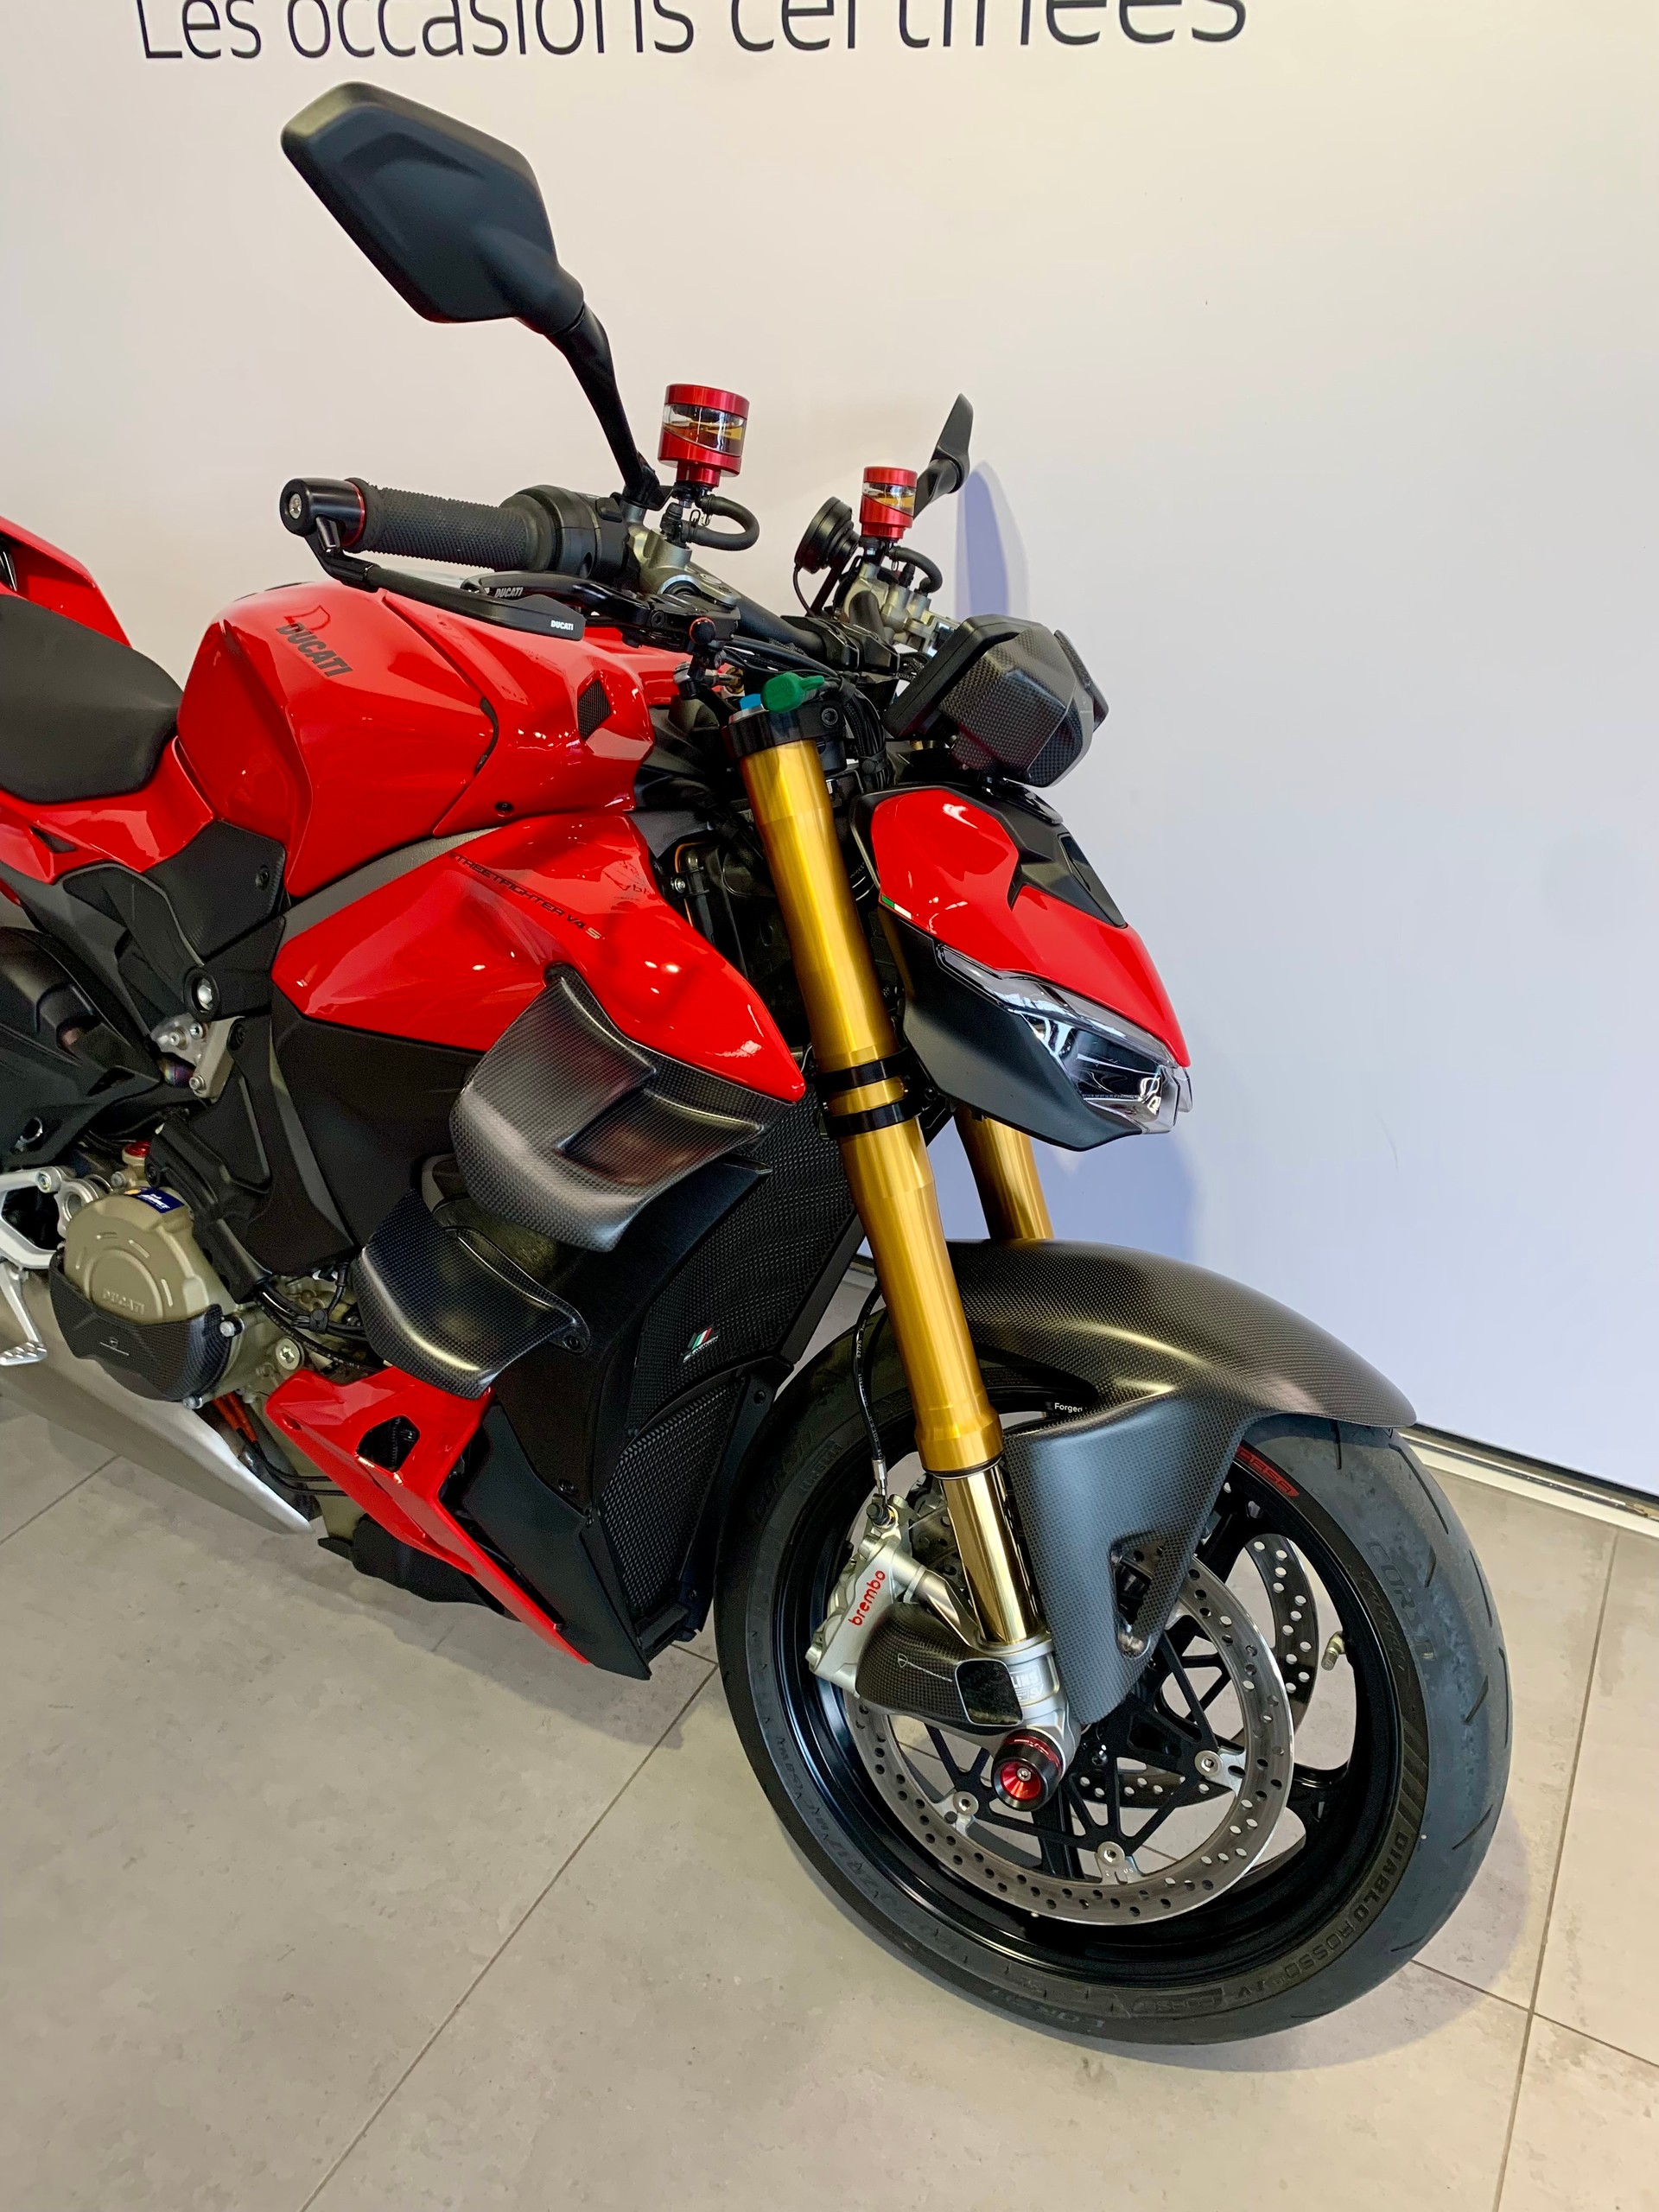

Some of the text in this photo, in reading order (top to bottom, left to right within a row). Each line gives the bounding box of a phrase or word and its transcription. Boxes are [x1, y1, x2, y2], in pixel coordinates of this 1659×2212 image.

[137, 0, 262, 60] Les
[494, 587, 524, 598] DUCATI
[276, 622, 353, 677] DUCATI
[550, 620, 574, 631] DUCATI
[449, 852, 565, 917] STREETFIGHTER
[567, 914, 586, 929] V4
[103, 1288, 145, 1315] DUCATI
[1236, 1447, 1293, 1494] ORSA
[848, 1570, 886, 1626] brembo
[1354, 1830, 1411, 1923] DIABLO
[1284, 1919, 1356, 1979] ROSSO
